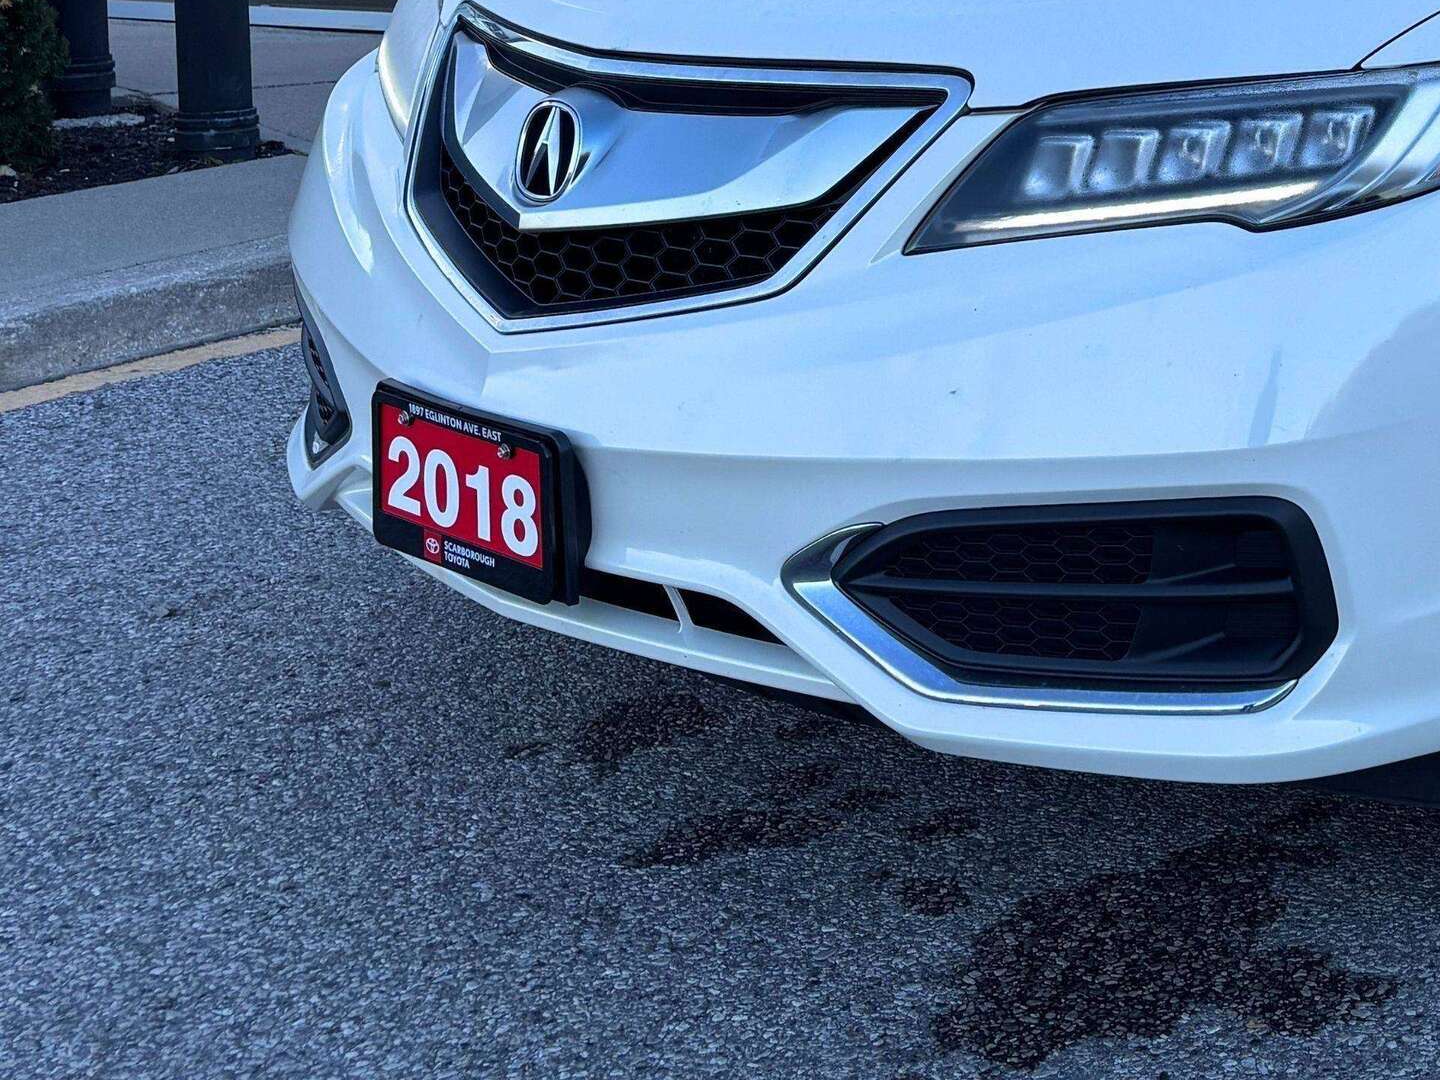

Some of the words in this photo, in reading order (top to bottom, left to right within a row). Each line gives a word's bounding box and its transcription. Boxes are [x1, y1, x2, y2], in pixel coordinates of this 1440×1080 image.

[408, 403, 424, 417] 1897
[424, 409, 462, 430] EGLINTON
[463, 421, 482, 437] AVE.
[482, 427, 502, 442] EAST
[387, 435, 539, 557] 2018
[443, 540, 496, 568] SCARBOROUGH
[444, 551, 471, 570] TOYOTA
